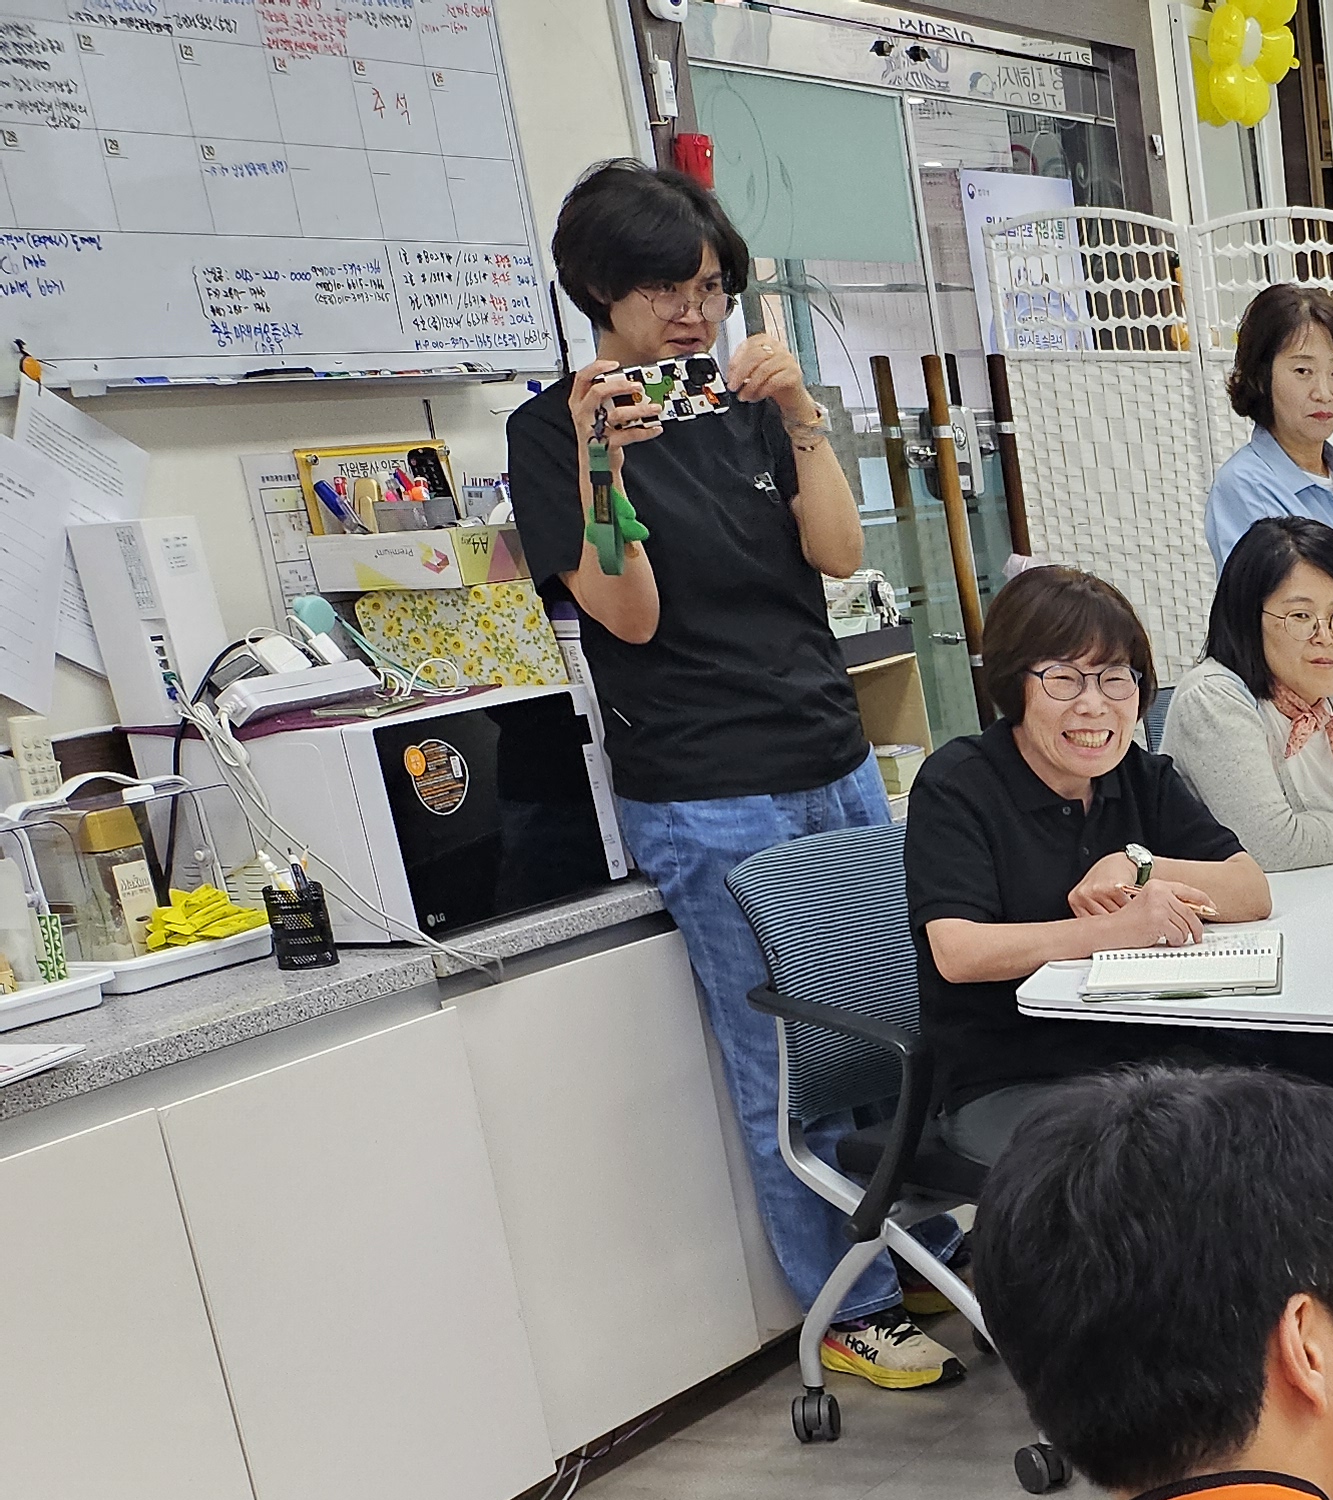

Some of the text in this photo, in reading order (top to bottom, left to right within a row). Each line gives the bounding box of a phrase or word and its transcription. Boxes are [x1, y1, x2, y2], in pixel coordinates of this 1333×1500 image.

[338, 461, 379, 478] 자원봉사
[378, 549, 414, 558] Premium
[472, 537, 488, 554] A4
[845, 1334, 879, 1364] HOKA
